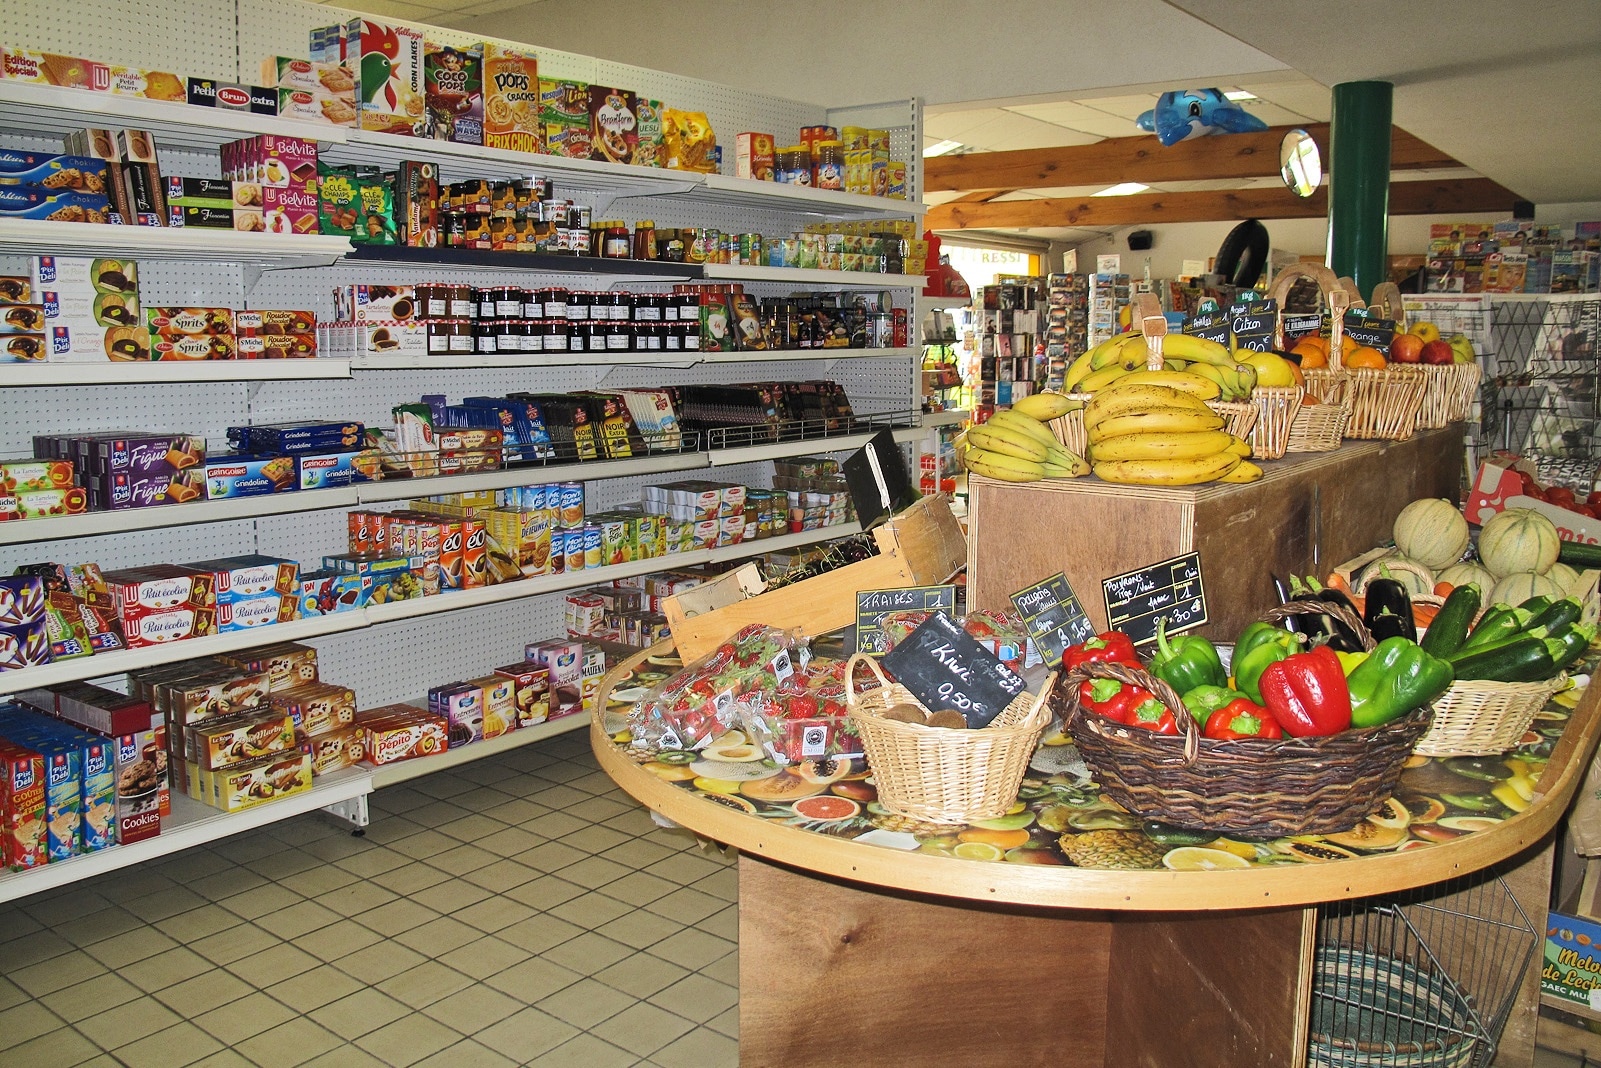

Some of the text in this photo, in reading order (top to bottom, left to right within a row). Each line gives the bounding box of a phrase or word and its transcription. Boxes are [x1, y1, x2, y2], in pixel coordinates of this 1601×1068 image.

[394, 26, 424, 40] Kellogg's
[4, 54, 37, 68] Edition
[4, 63, 38, 78] Spéciale
[95, 66, 109, 87] LU
[434, 70, 468, 82] COCO
[193, 84, 217, 97] Petit
[439, 81, 465, 92] POPS
[222, 91, 247, 103] Brun
[251, 96, 275, 107] extra
[507, 92, 535, 102] CRACKS
[568, 90, 588, 104] Lion
[487, 133, 510, 148] PRIX
[277, 140, 317, 156] Belvita
[279, 191, 318, 207] Belvita
[40, 273, 57, 281] Déli
[44, 308, 60, 317] Déli
[266, 312, 291, 320] Roudor
[175, 318, 205, 330] Sprits
[1233, 317, 1261, 333] Citron
[267, 336, 294, 344] Roudor
[54, 343, 70, 351] Déli
[178, 343, 208, 354] Sprits
[605, 422, 625, 431] NOIR
[285, 431, 311, 439] Grindoline
[286, 442, 312, 450] Grindoline
[111, 457, 128, 466] Déli
[130, 445, 168, 471] Figue
[325, 468, 357, 478] Grindoline
[234, 478, 269, 488] Grindoline
[113, 492, 130, 501] Déli
[132, 479, 169, 505] Figue
[218, 571, 230, 590] LU
[233, 574, 275, 586] Petit écolier
[125, 585, 139, 603] LU
[142, 586, 188, 600] Petit écolier
[304, 582, 315, 594] BN
[860, 590, 914, 609] FRAISES
[220, 604, 232, 623] LU
[235, 605, 277, 618] Petit écolier
[126, 619, 140, 637] LU
[143, 619, 190, 633] Petit écolier
[931, 643, 975, 683] Kiwi
[582, 664, 605, 678] MAIZENA
[554, 673, 580, 688] chocolat
[487, 696, 514, 712] Entremets
[453, 704, 481, 720] Entremets
[121, 745, 134, 753] P'tit
[378, 735, 411, 754] Pépito
[88, 756, 102, 764] P'tit
[120, 751, 137, 761] Déli
[53, 765, 67, 773] P'tit
[87, 762, 105, 774] Déli
[15, 771, 31, 780] P'tit
[52, 771, 69, 783] Déli
[15, 777, 33, 788] Déli
[122, 813, 160, 830] Cookies
[1558, 947, 1601, 975] Melo
[1541, 963, 1560, 981] de
